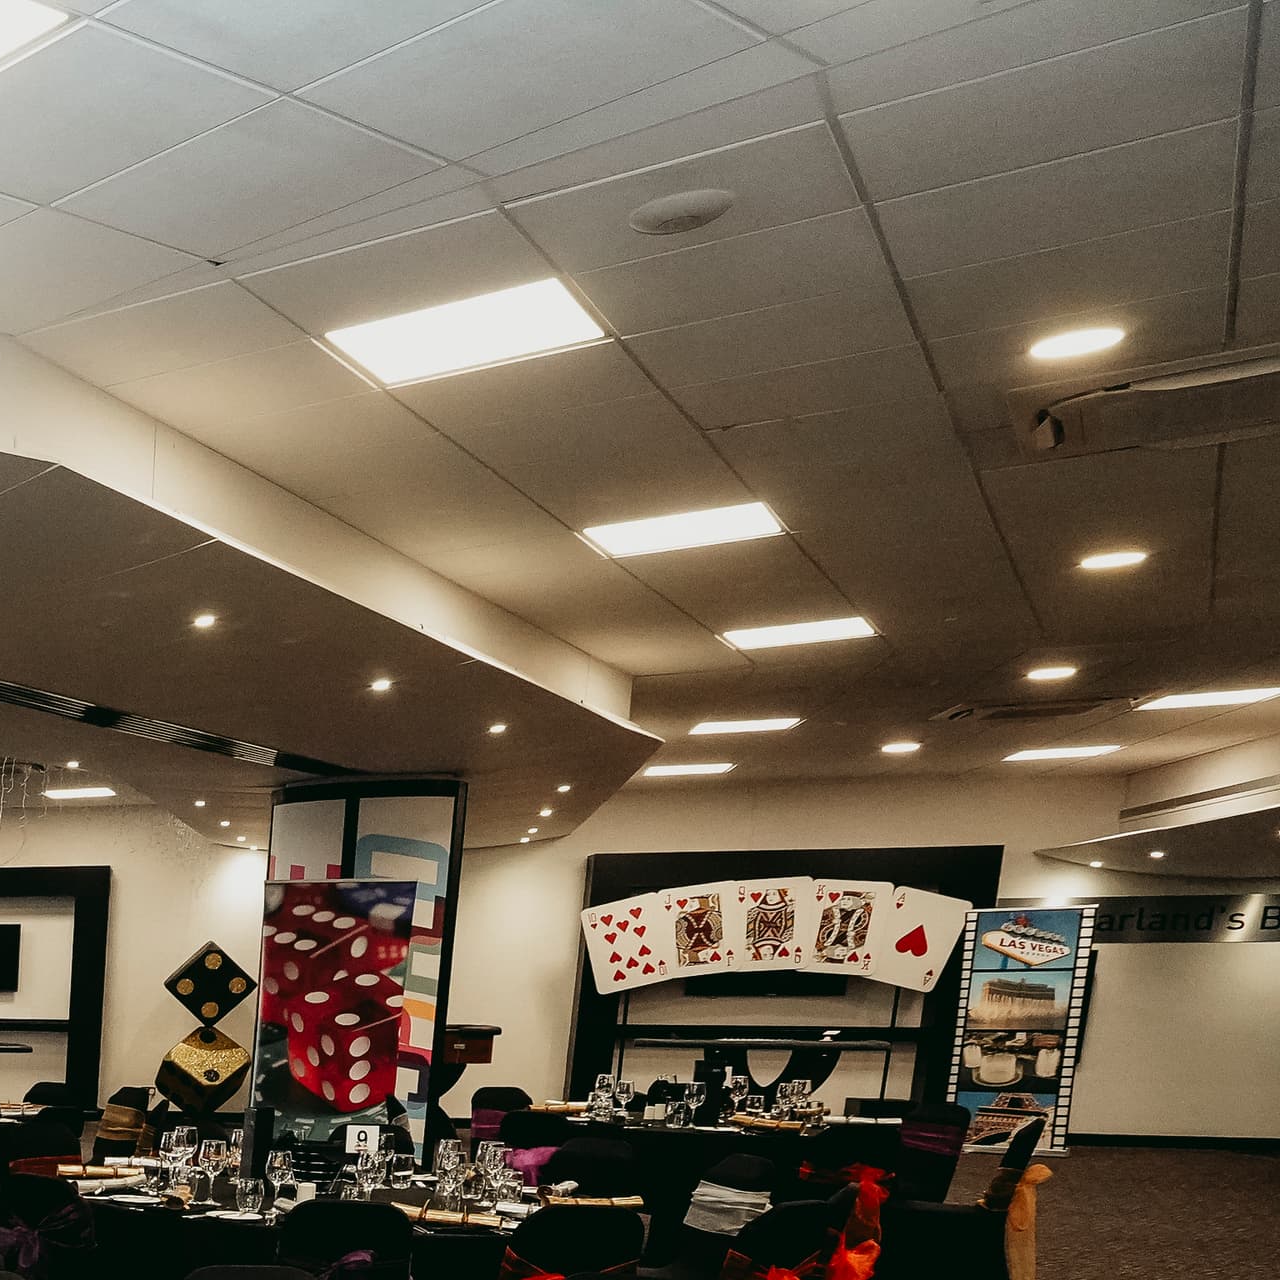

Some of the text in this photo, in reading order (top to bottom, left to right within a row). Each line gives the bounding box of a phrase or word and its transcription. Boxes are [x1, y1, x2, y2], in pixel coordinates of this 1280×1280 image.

[1096, 906, 1246, 931] arland's
[999, 938, 1026, 950] LAS
[1030, 942, 1065, 955] VEGAS
